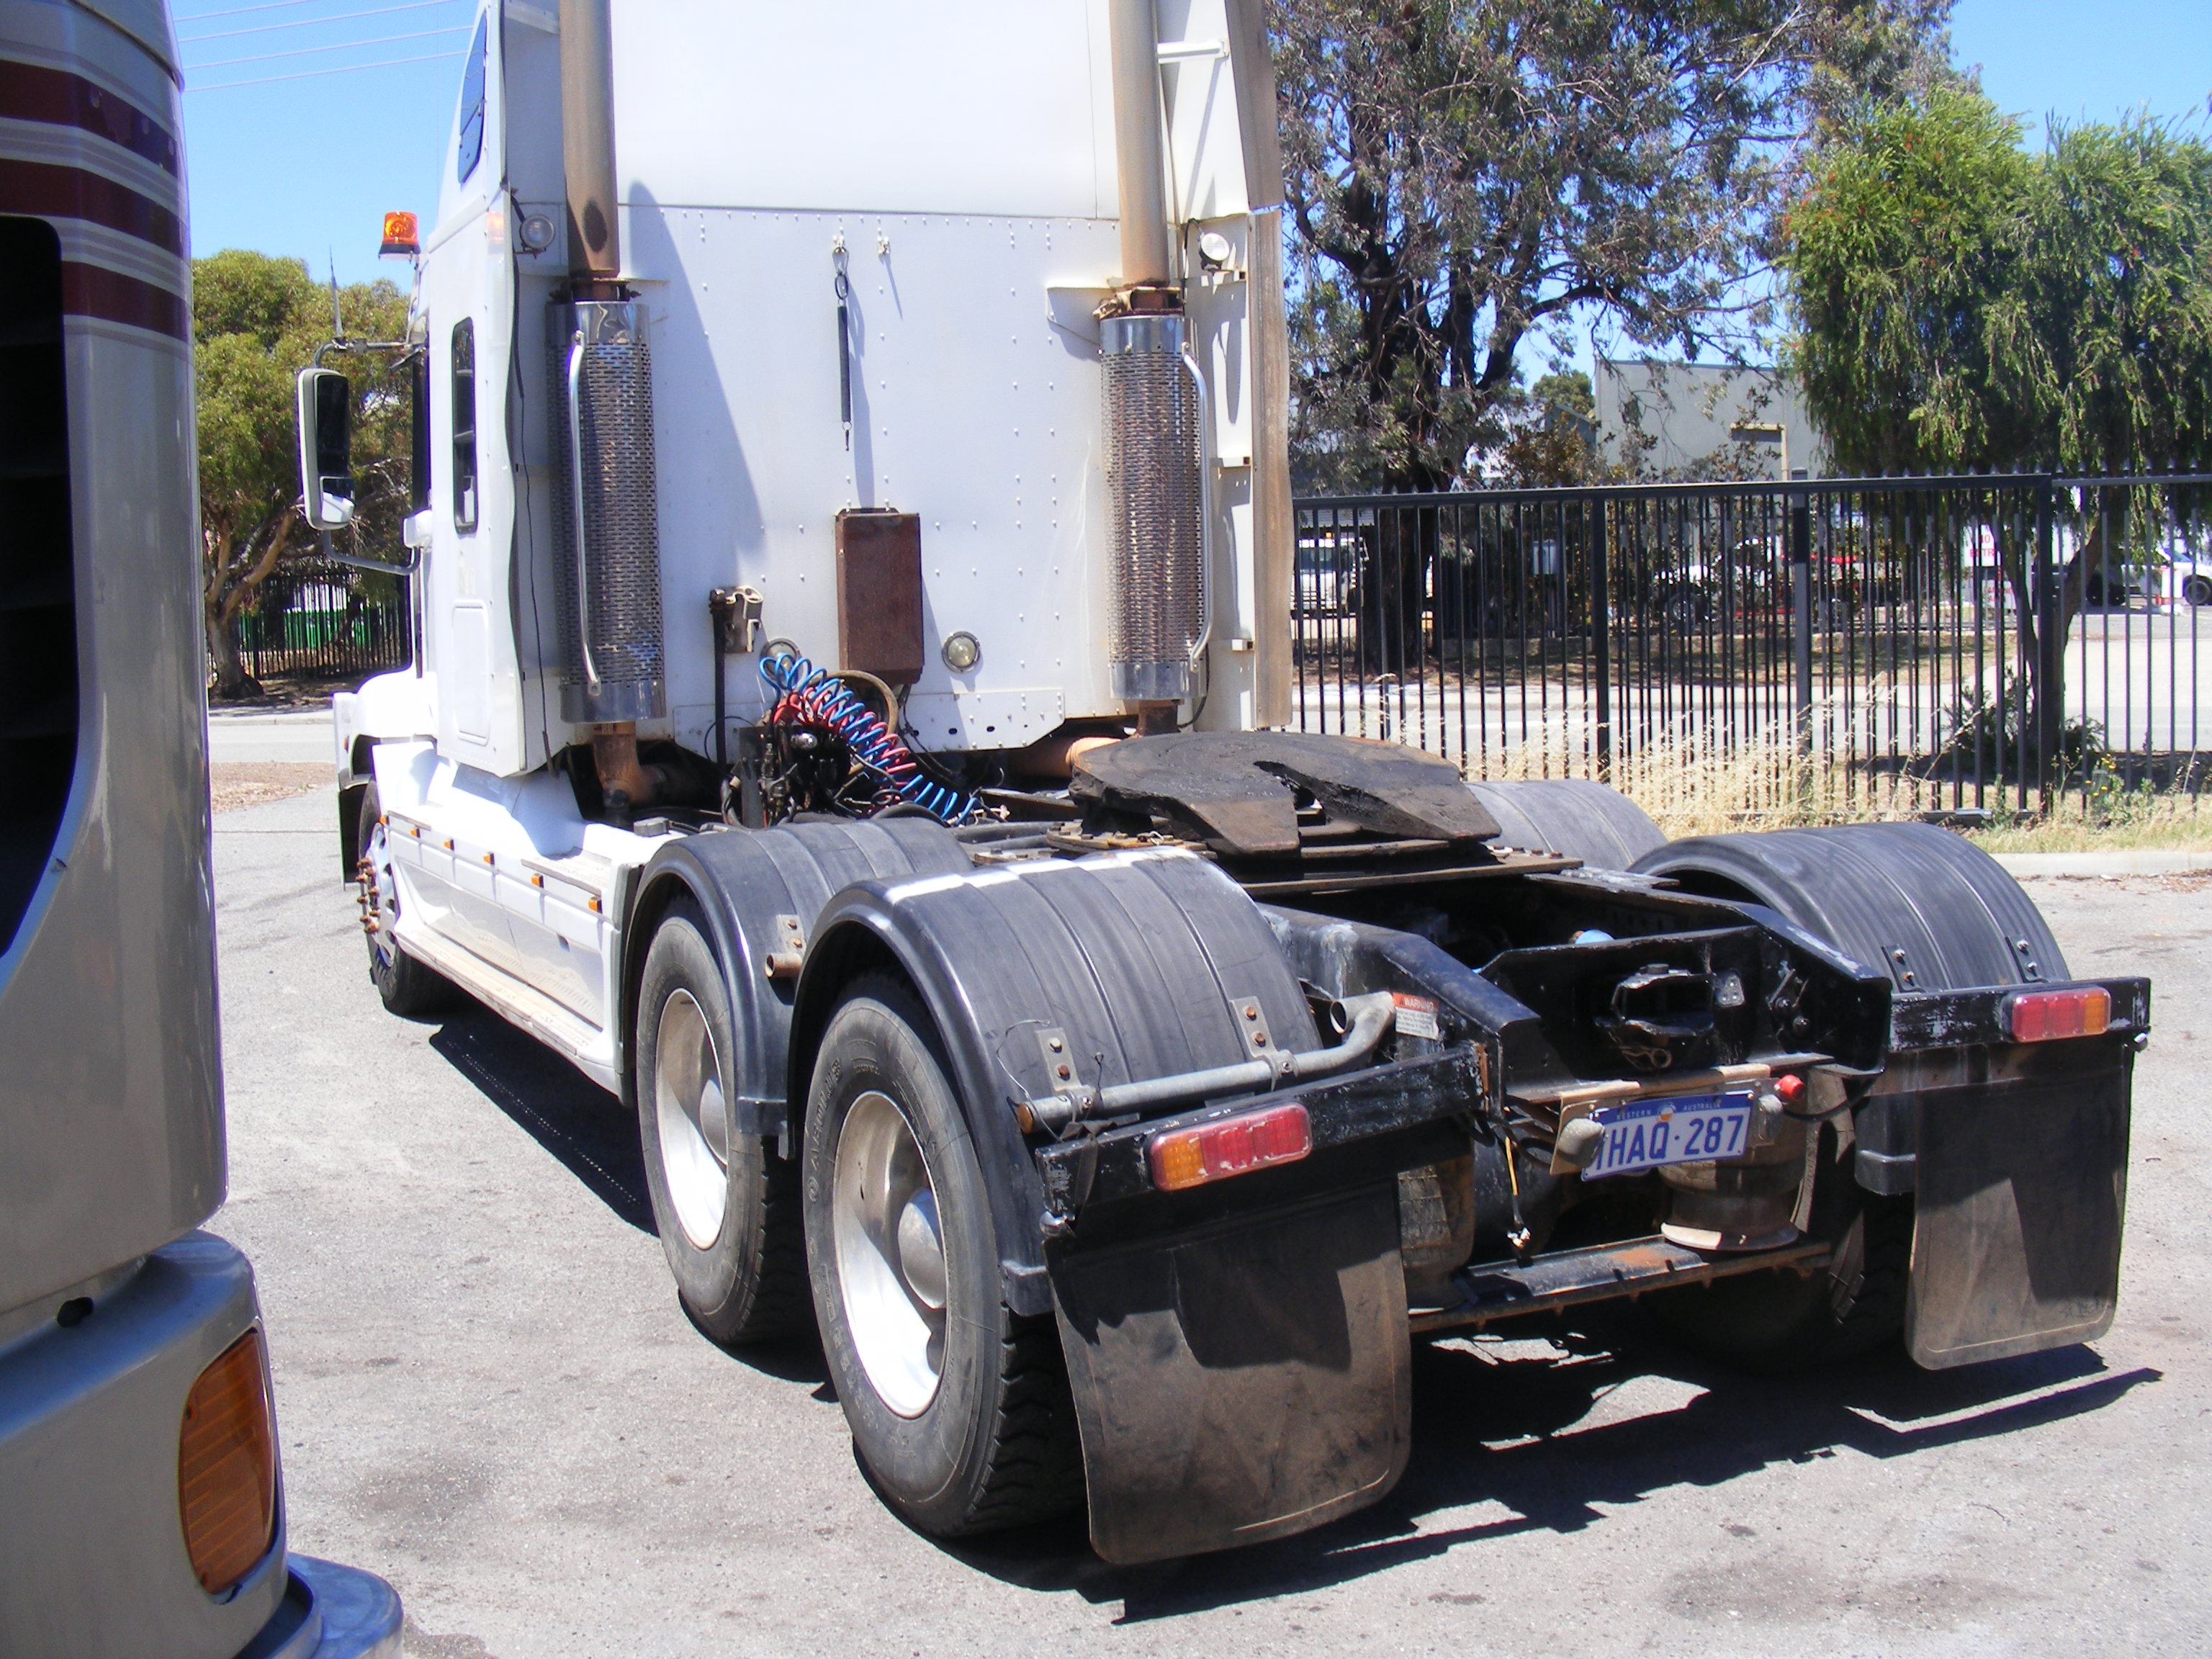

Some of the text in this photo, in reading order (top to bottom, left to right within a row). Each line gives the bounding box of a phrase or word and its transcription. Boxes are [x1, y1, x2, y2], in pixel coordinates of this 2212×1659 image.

[1403, 997, 1434, 1010] WARNING
[1617, 1102, 1721, 1120] WESTERN AUSTRALIA
